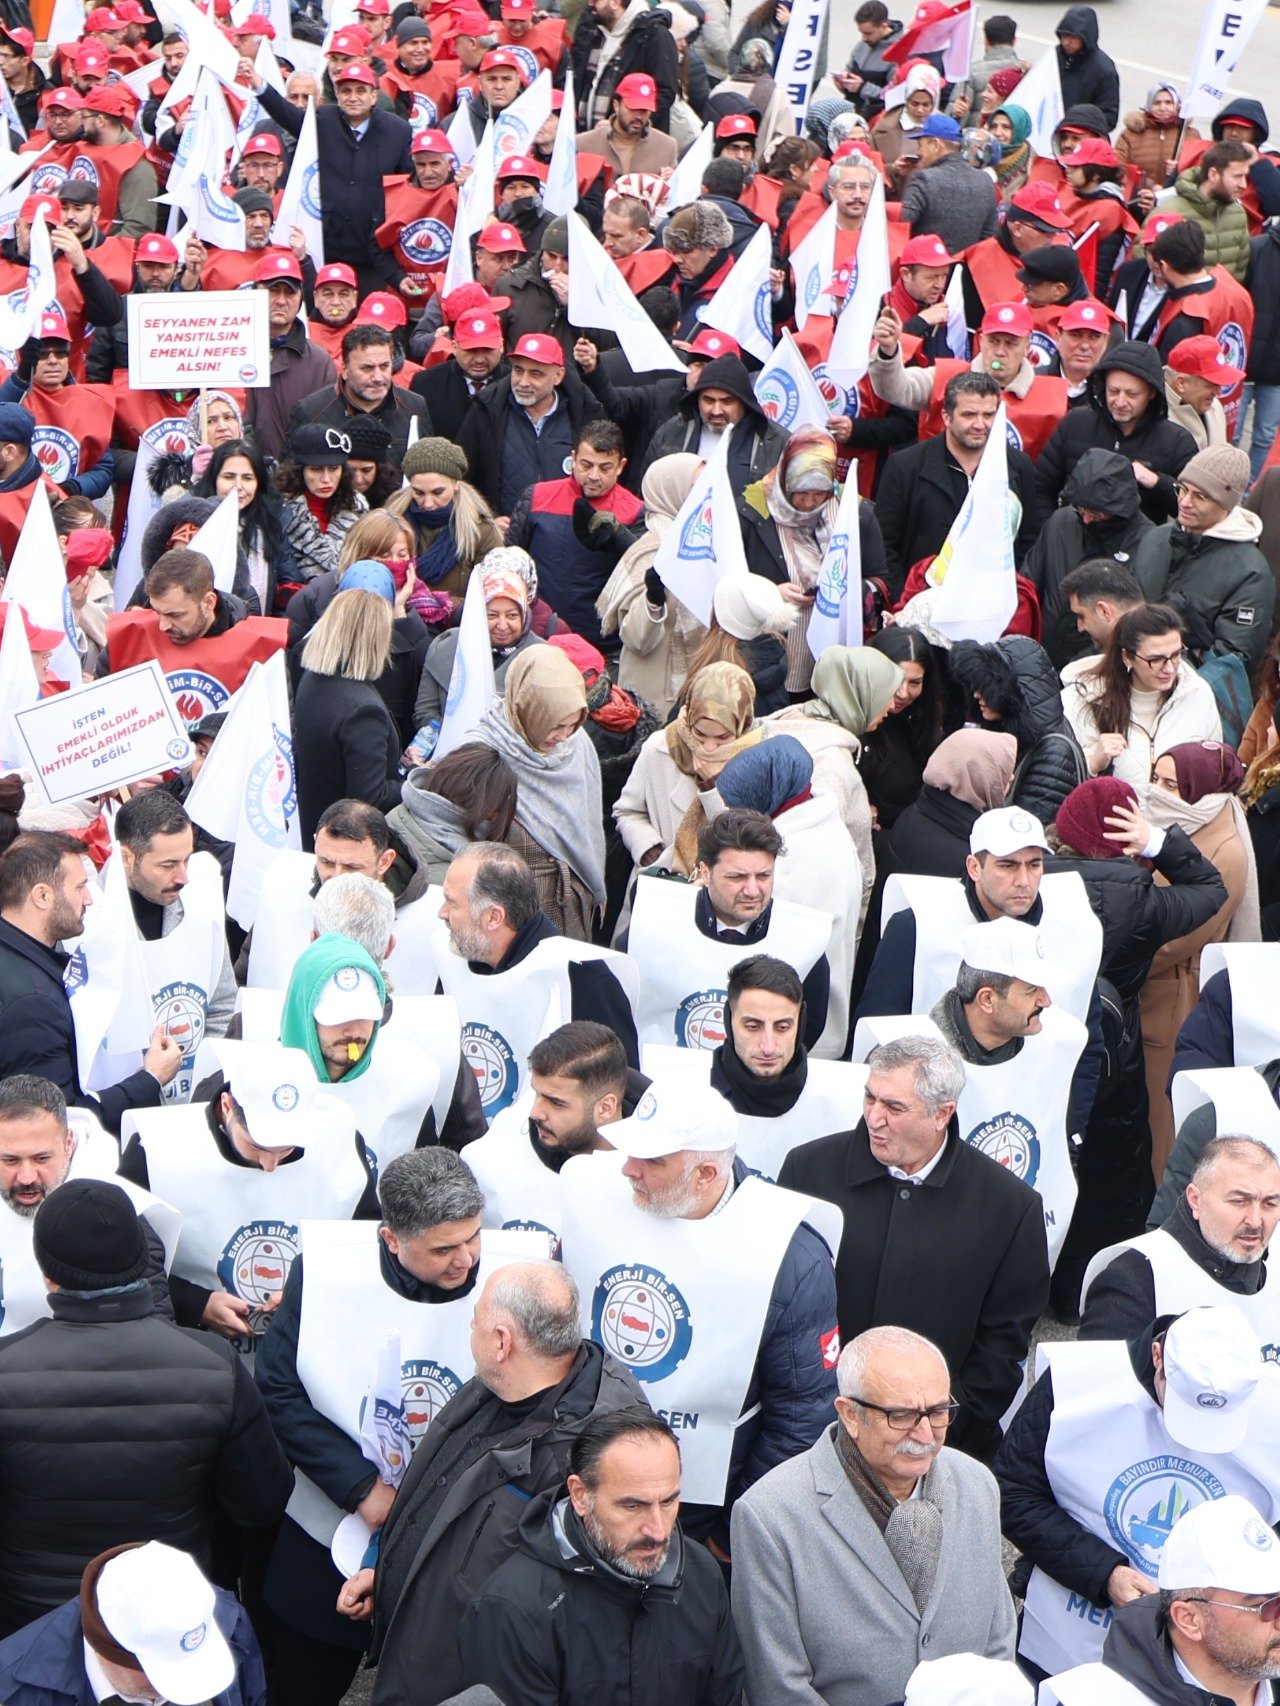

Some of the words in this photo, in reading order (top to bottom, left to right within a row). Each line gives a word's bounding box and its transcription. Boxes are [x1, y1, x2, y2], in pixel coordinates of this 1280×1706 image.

[143, 317, 218, 329] SEYYANEN
[220, 316, 252, 327] ZAM
[156, 331, 240, 343] YANSITILSIN
[149, 345, 200, 358] EMEKLİ
[202, 346, 248, 357] NEFES
[176, 362, 222, 372] ALSIN!
[56, 728, 99, 754] EMEKLİ
[100, 706, 140, 732] OLDUK
[72, 707, 106, 730] İŞTEN
[40, 708, 167, 777] İHTİYAÇLARIMIZDAN
[91, 741, 133, 769] DEĞİL!
[173, 984, 207, 1006] BİR-SEN
[684, 992, 717, 1012] ENERJİ
[474, 1027, 510, 1060] BİR-SEN
[227, 1224, 263, 1259] ENERJİ
[603, 1269, 644, 1291] ENERJİ
[645, 1274, 685, 1321] BİR-SEN
[1119, 1456, 1167, 1486] BAYINDIR
[1166, 1455, 1224, 1498] MEMUR-SEN
